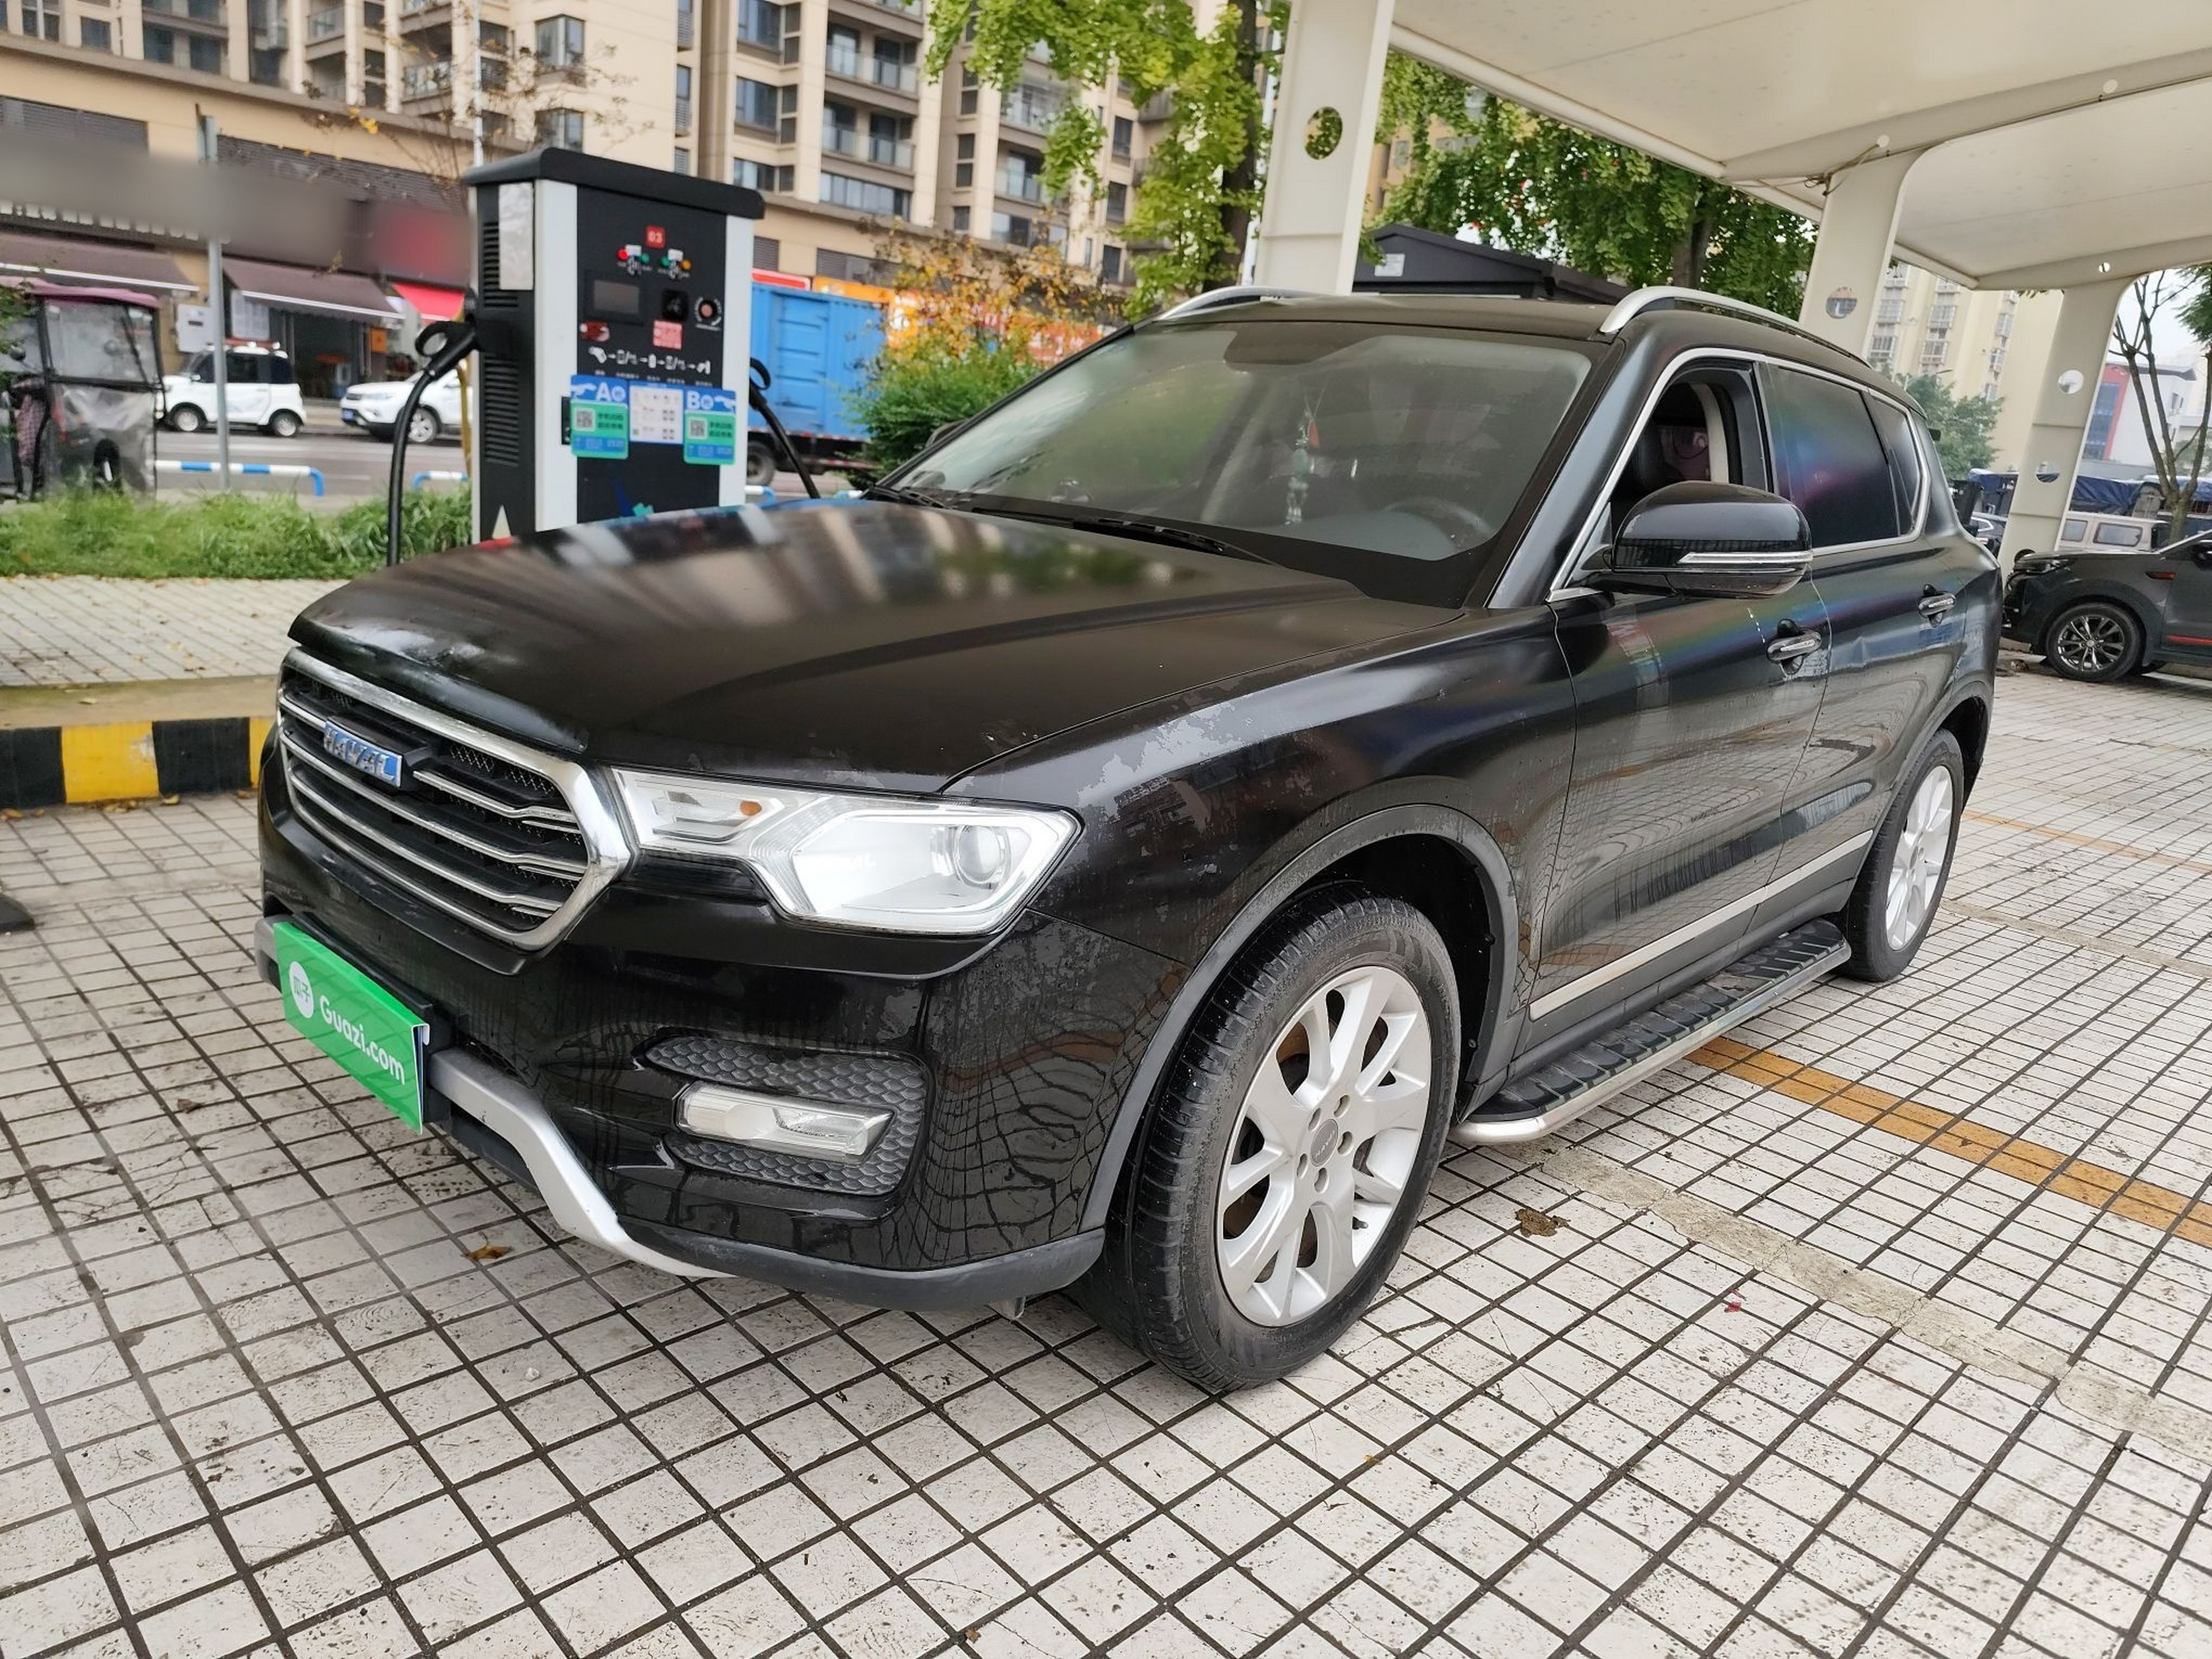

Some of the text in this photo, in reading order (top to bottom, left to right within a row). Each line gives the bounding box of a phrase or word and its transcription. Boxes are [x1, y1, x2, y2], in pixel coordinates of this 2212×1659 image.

[647, 231, 662, 244] 03
[324, 727, 395, 782] HAVAL
[320, 995, 406, 1085] Guazi.com
